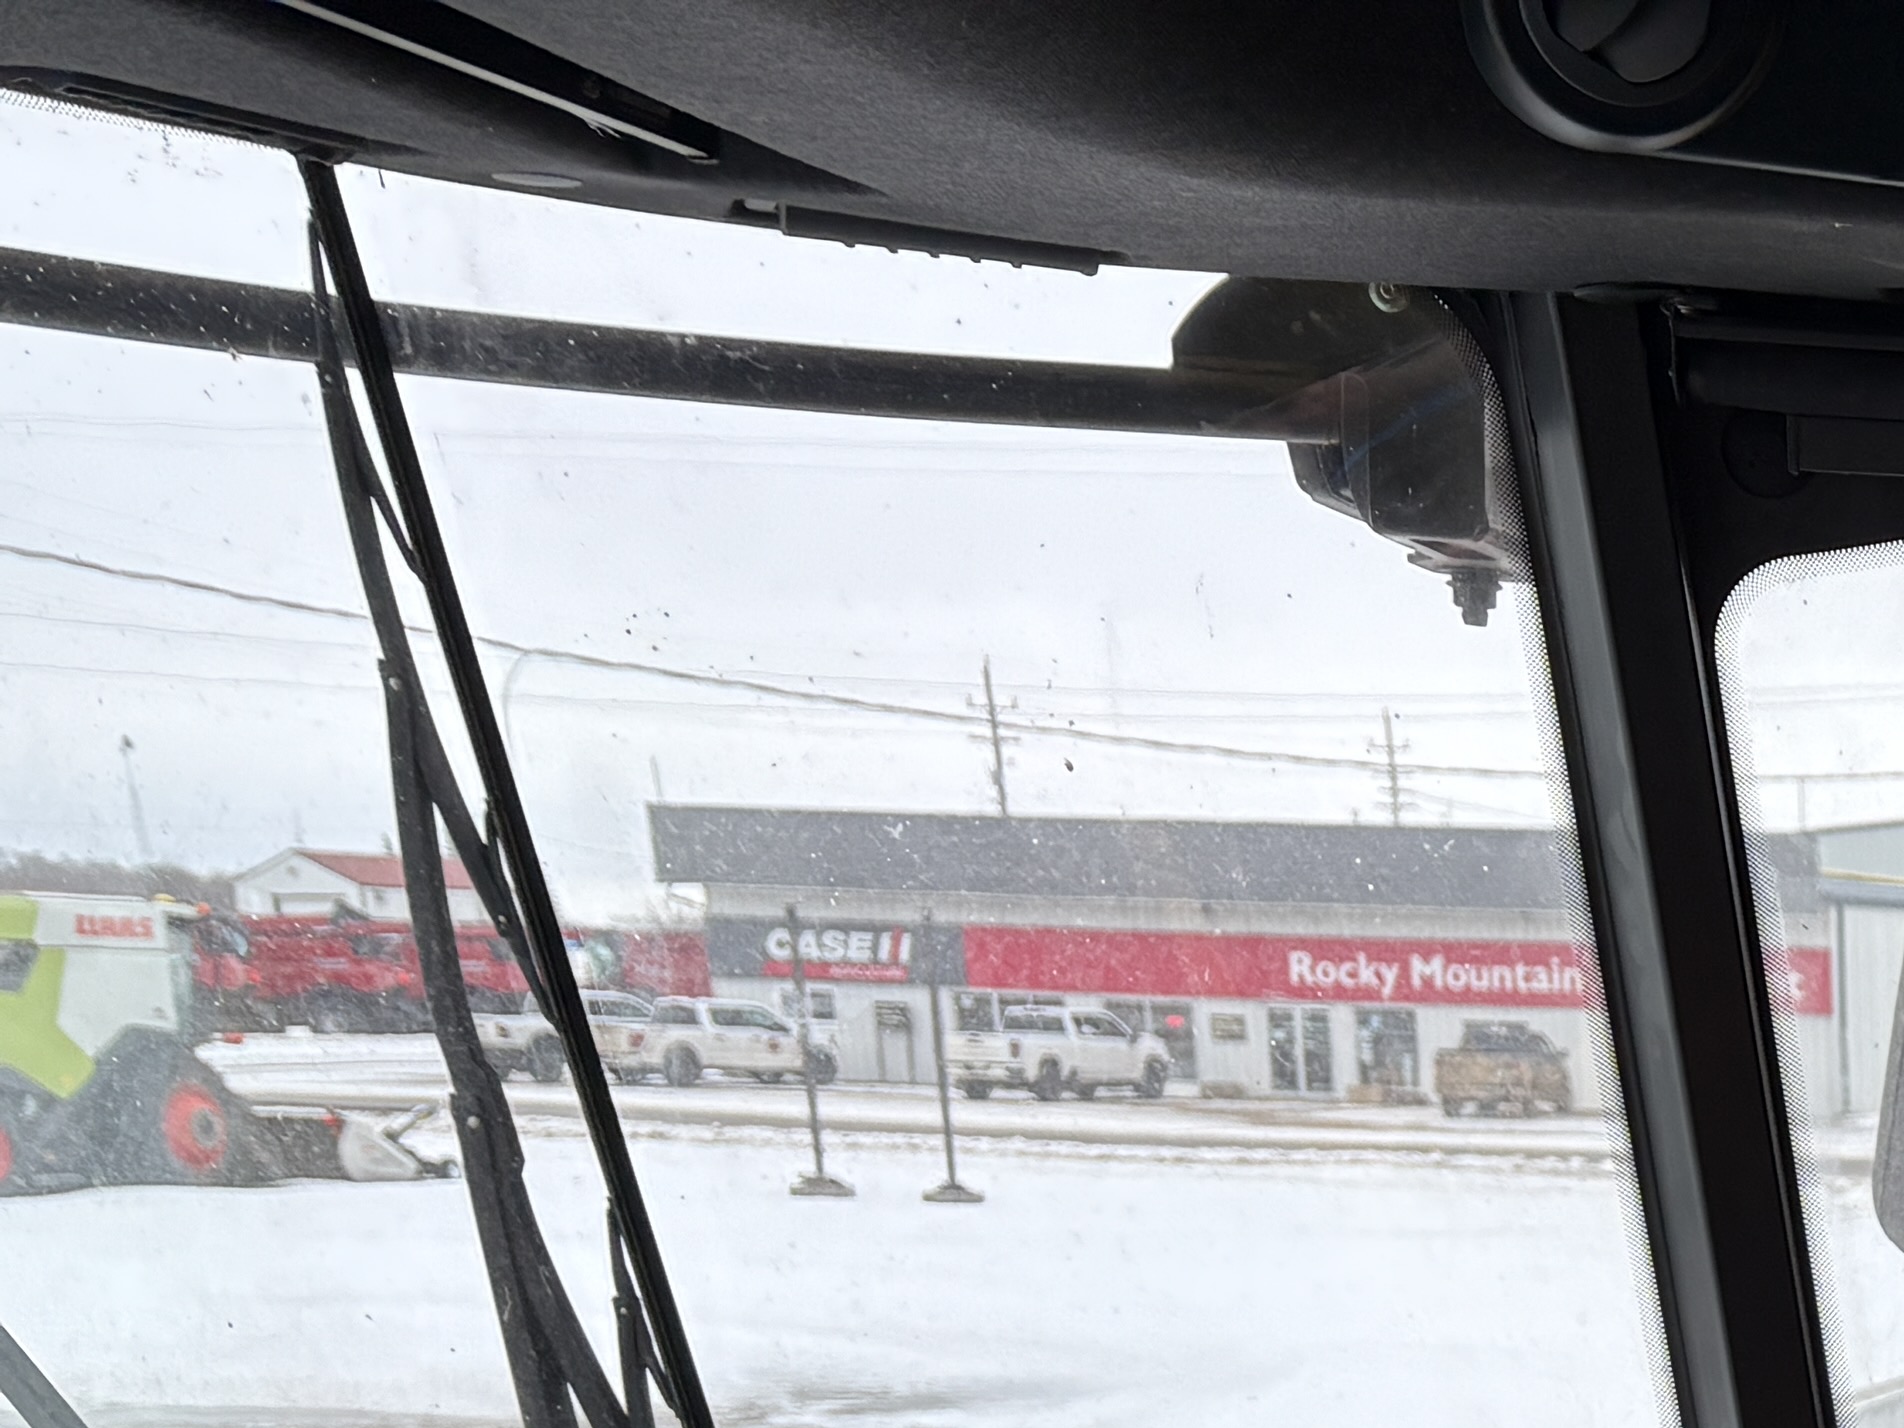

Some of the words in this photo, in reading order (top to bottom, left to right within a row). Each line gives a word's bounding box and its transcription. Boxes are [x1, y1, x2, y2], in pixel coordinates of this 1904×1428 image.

[765, 927, 874, 961] CASE
[1288, 950, 1399, 1000] Rocky
[1409, 953, 1584, 993] Mountain
